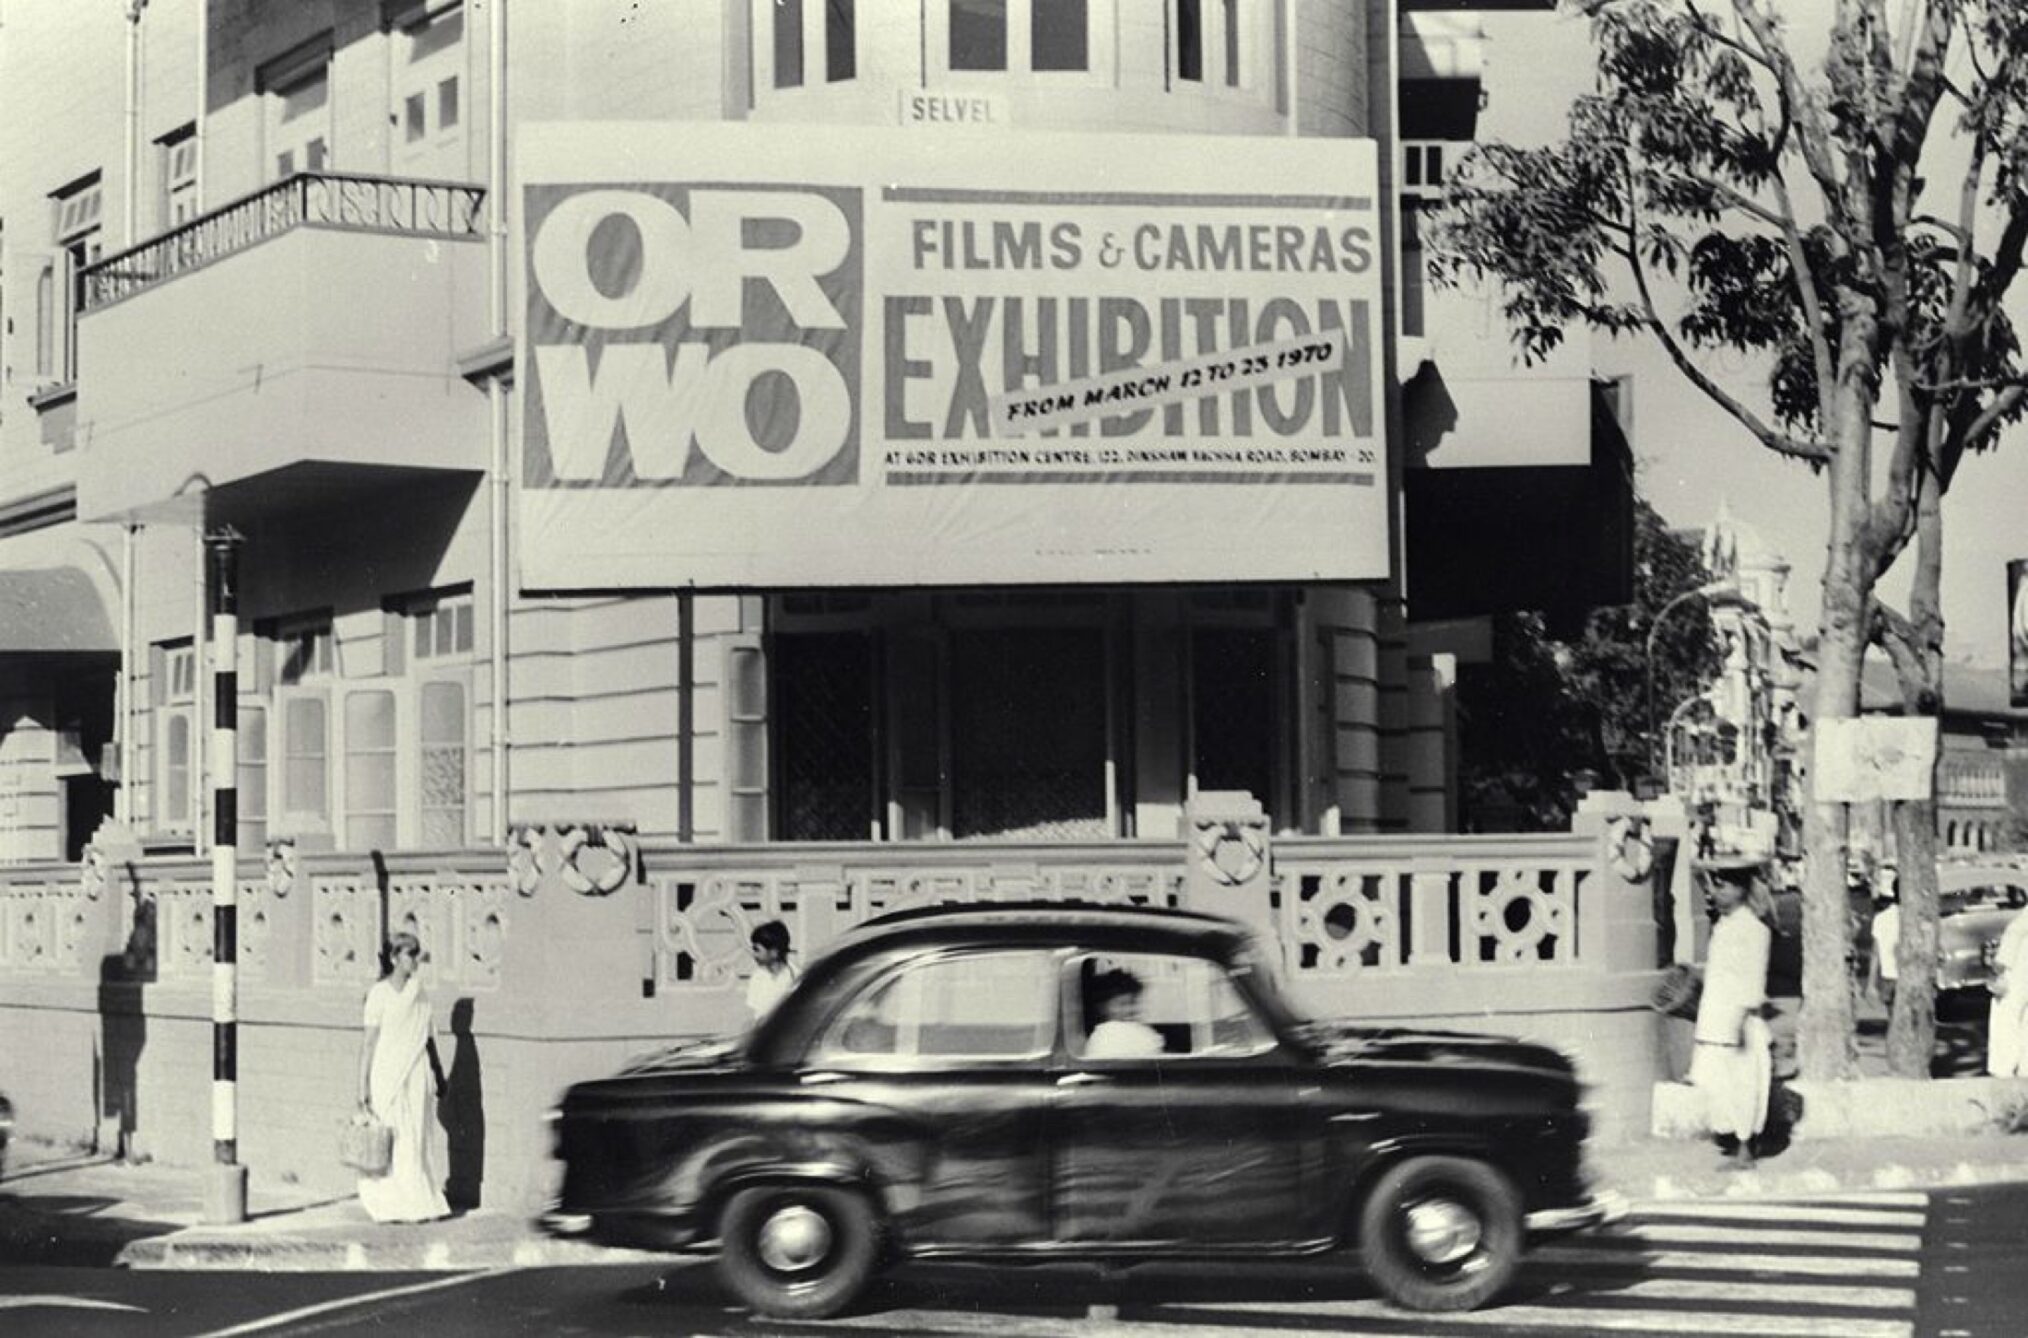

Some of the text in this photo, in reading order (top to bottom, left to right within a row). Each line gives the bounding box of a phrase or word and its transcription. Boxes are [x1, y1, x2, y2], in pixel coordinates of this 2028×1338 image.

[912, 97, 994, 122] SELVEL
[532, 189, 851, 329] OR
[912, 220, 1372, 273] FILMS & CAMERAS
[884, 296, 1374, 439] EXHIBITION
[1007, 394, 1075, 421] FROM
[1084, 375, 1171, 406] MARCH
[1180, 368, 1203, 388] 12
[1206, 361, 1236, 382] TO
[1276, 341, 1333, 369] 1970
[534, 342, 851, 480] WO
[884, 451, 901, 466] AT
[941, 450, 1030, 465] EXHIBITION
[1290, 450, 1346, 463] BOMBAY
